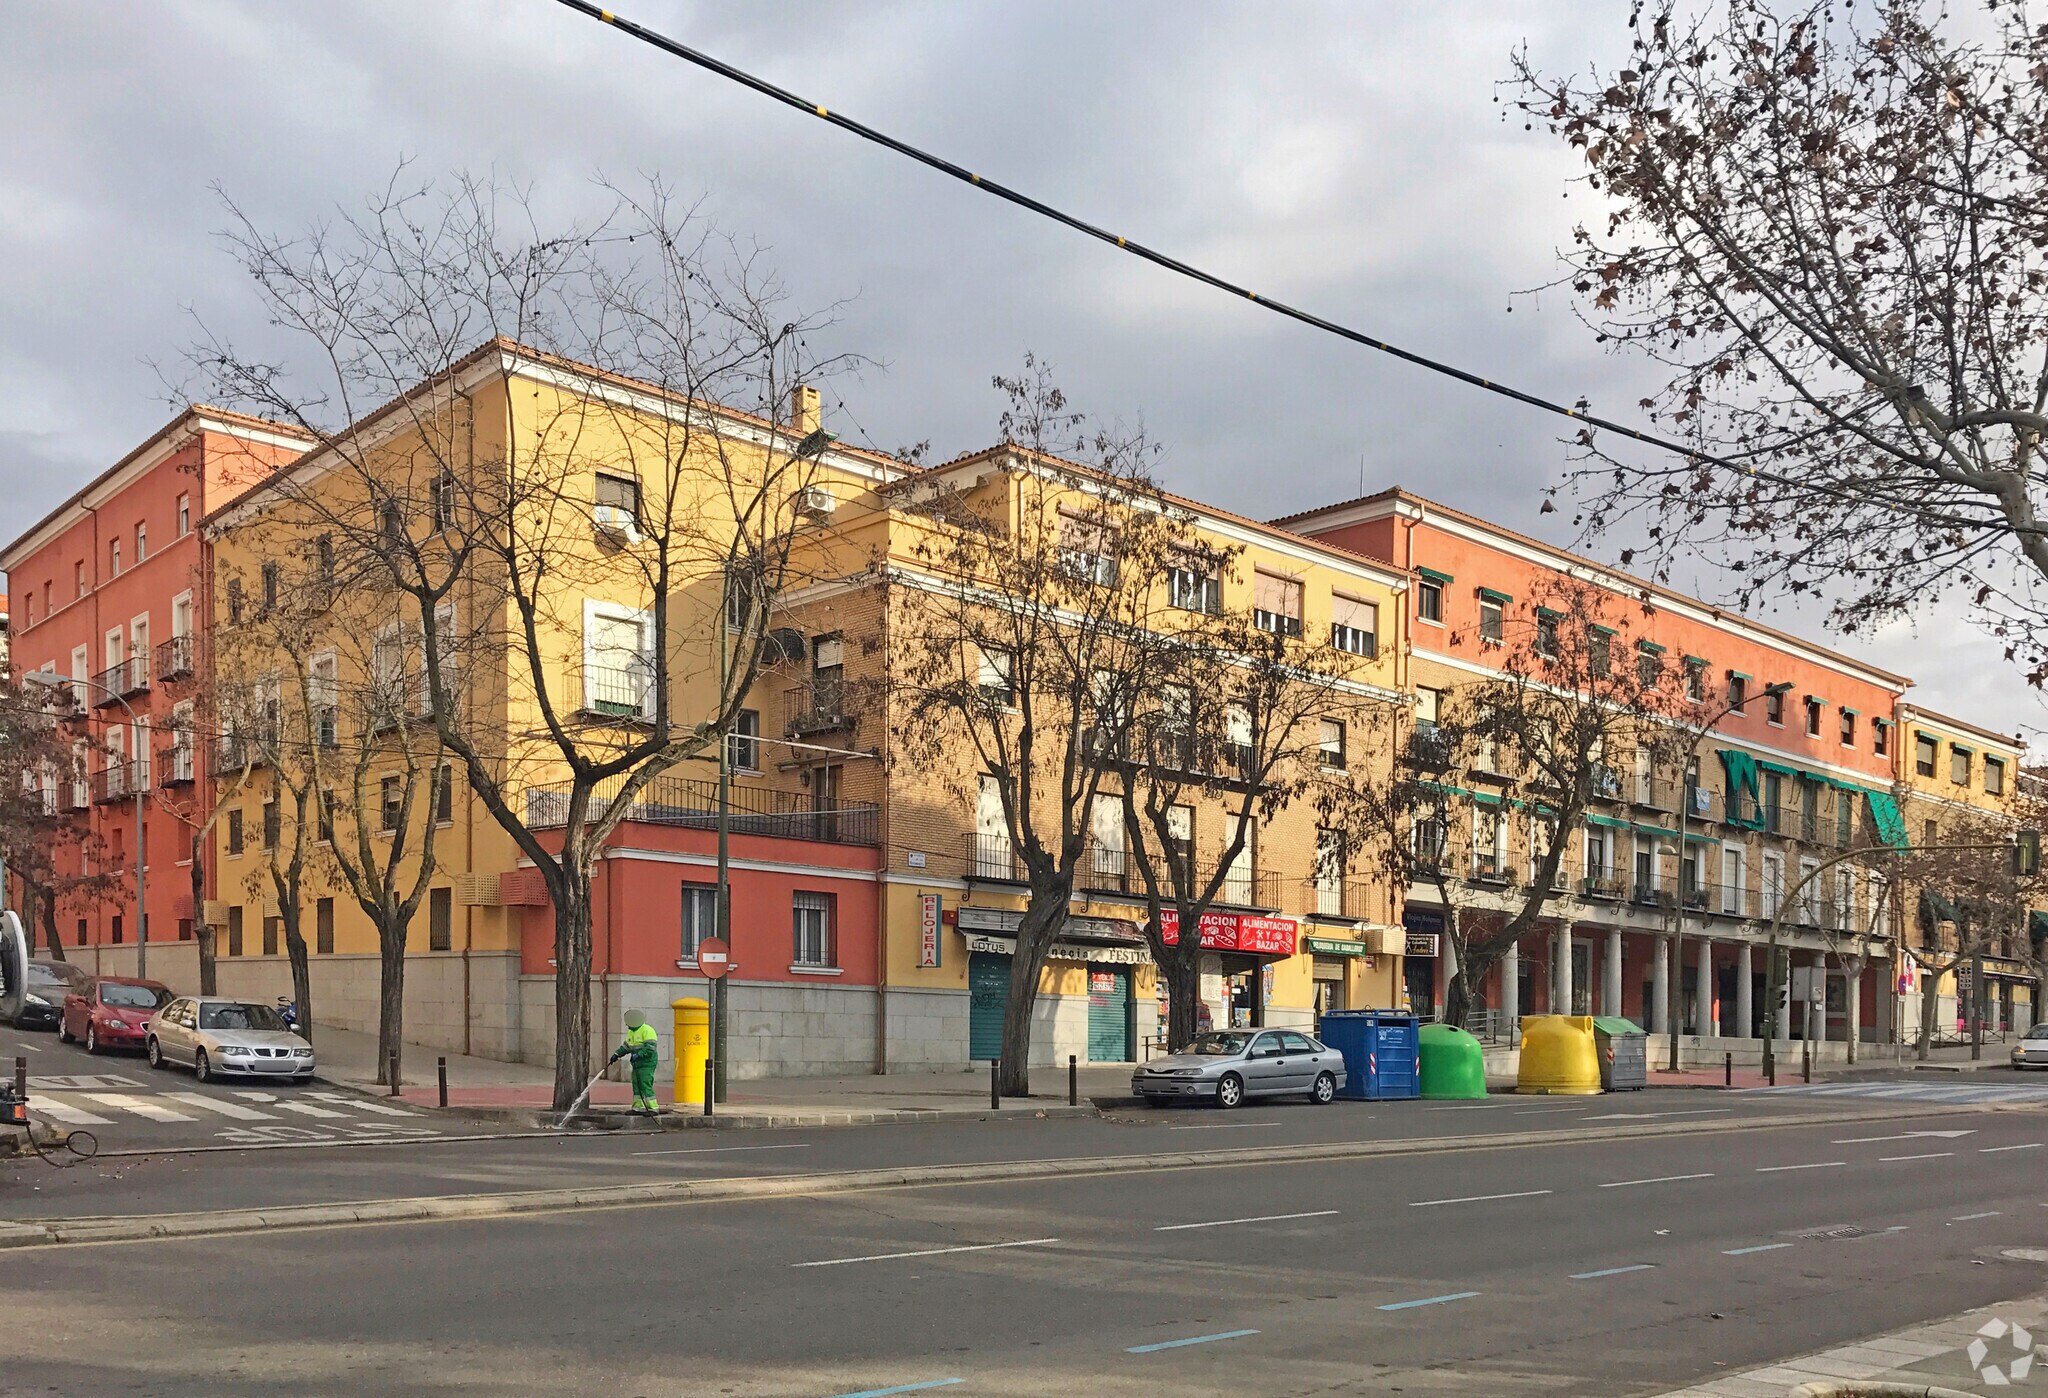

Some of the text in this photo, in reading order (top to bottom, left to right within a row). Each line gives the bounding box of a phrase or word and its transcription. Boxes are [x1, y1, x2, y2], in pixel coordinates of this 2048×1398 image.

[1160, 912, 1237, 926] ALITACION
[1241, 918, 1294, 931] ALIMENTACION
[923, 896, 935, 966] RELOJERIA
[1266, 931, 1271, 939] Y
[971, 940, 1005, 952] LOTUS
[1255, 940, 1280, 951] BAZAR
